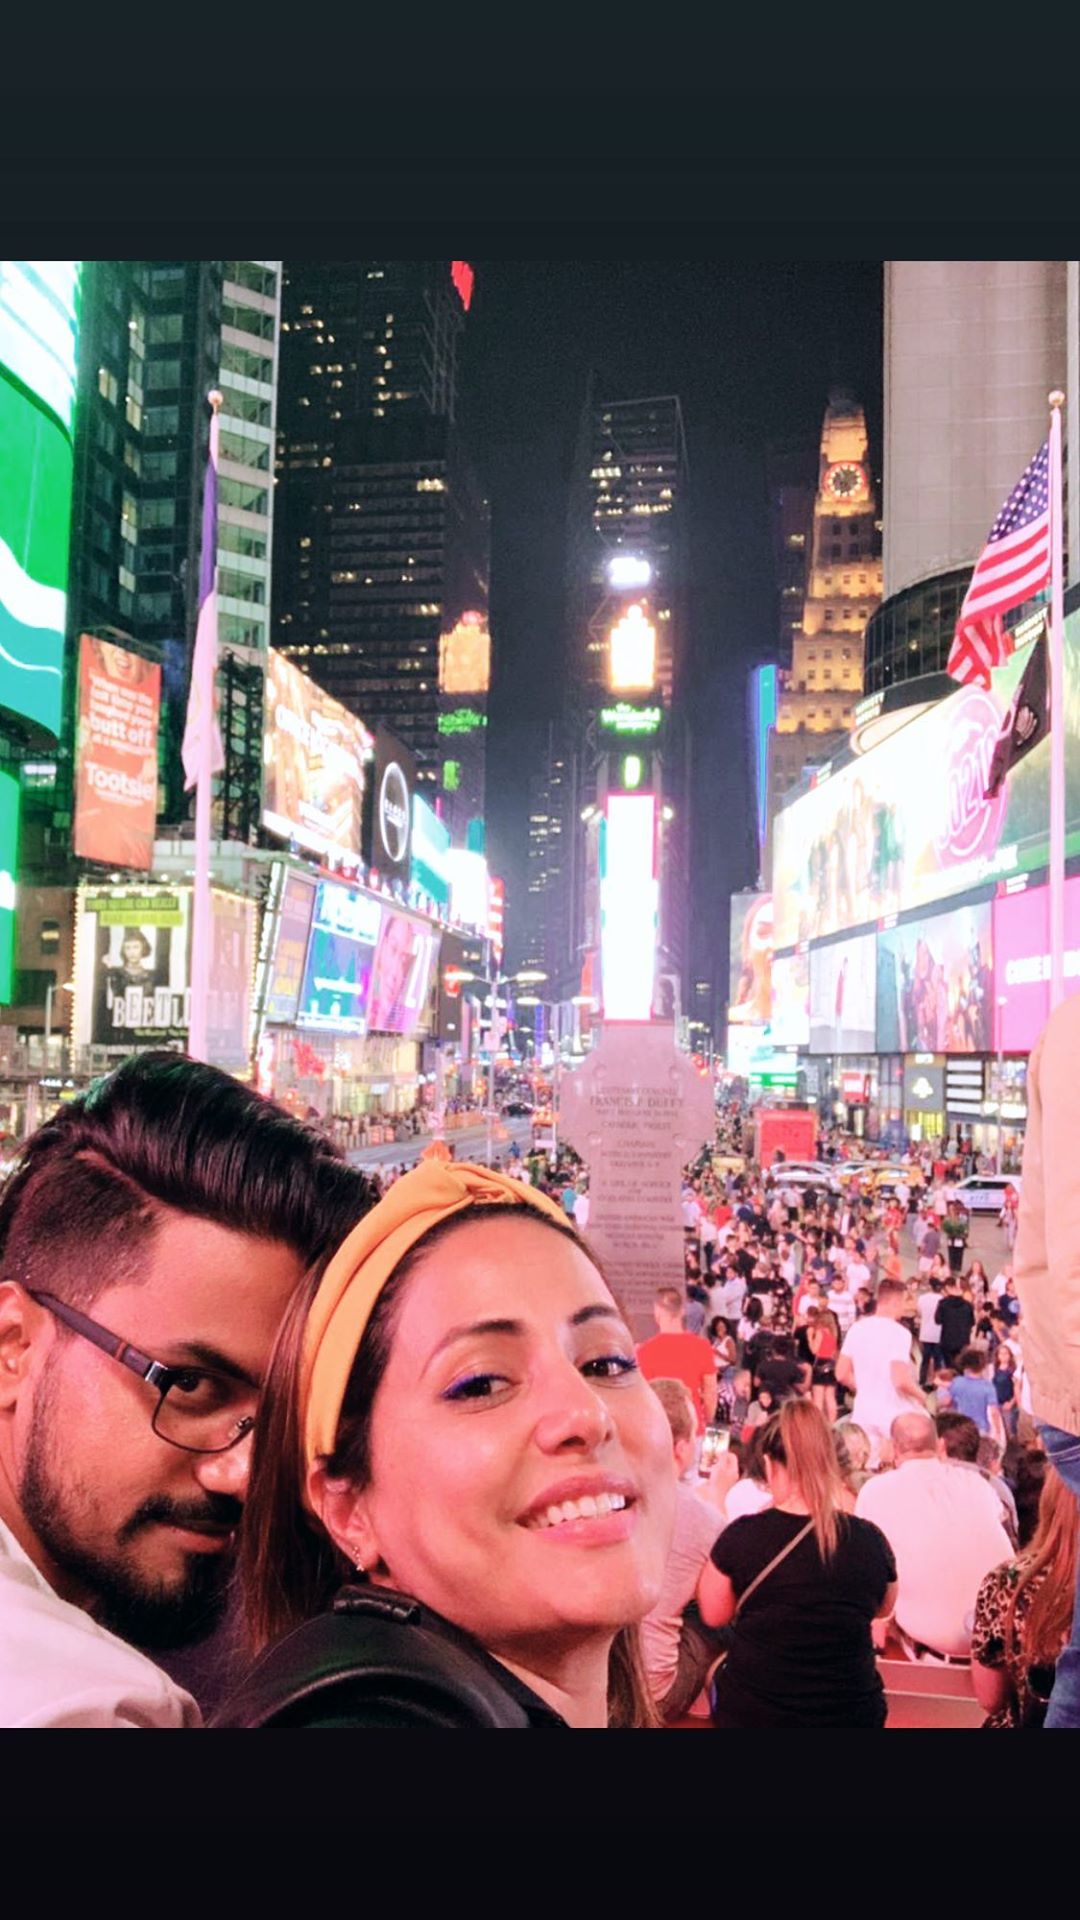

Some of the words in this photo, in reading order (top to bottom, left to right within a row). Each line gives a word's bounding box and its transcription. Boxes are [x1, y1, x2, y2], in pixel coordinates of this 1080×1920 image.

[90, 712, 127, 740] butt
[128, 728, 153, 747] off
[84, 761, 154, 800] Tootsie
[647, 1097, 684, 1108] DUFFY
